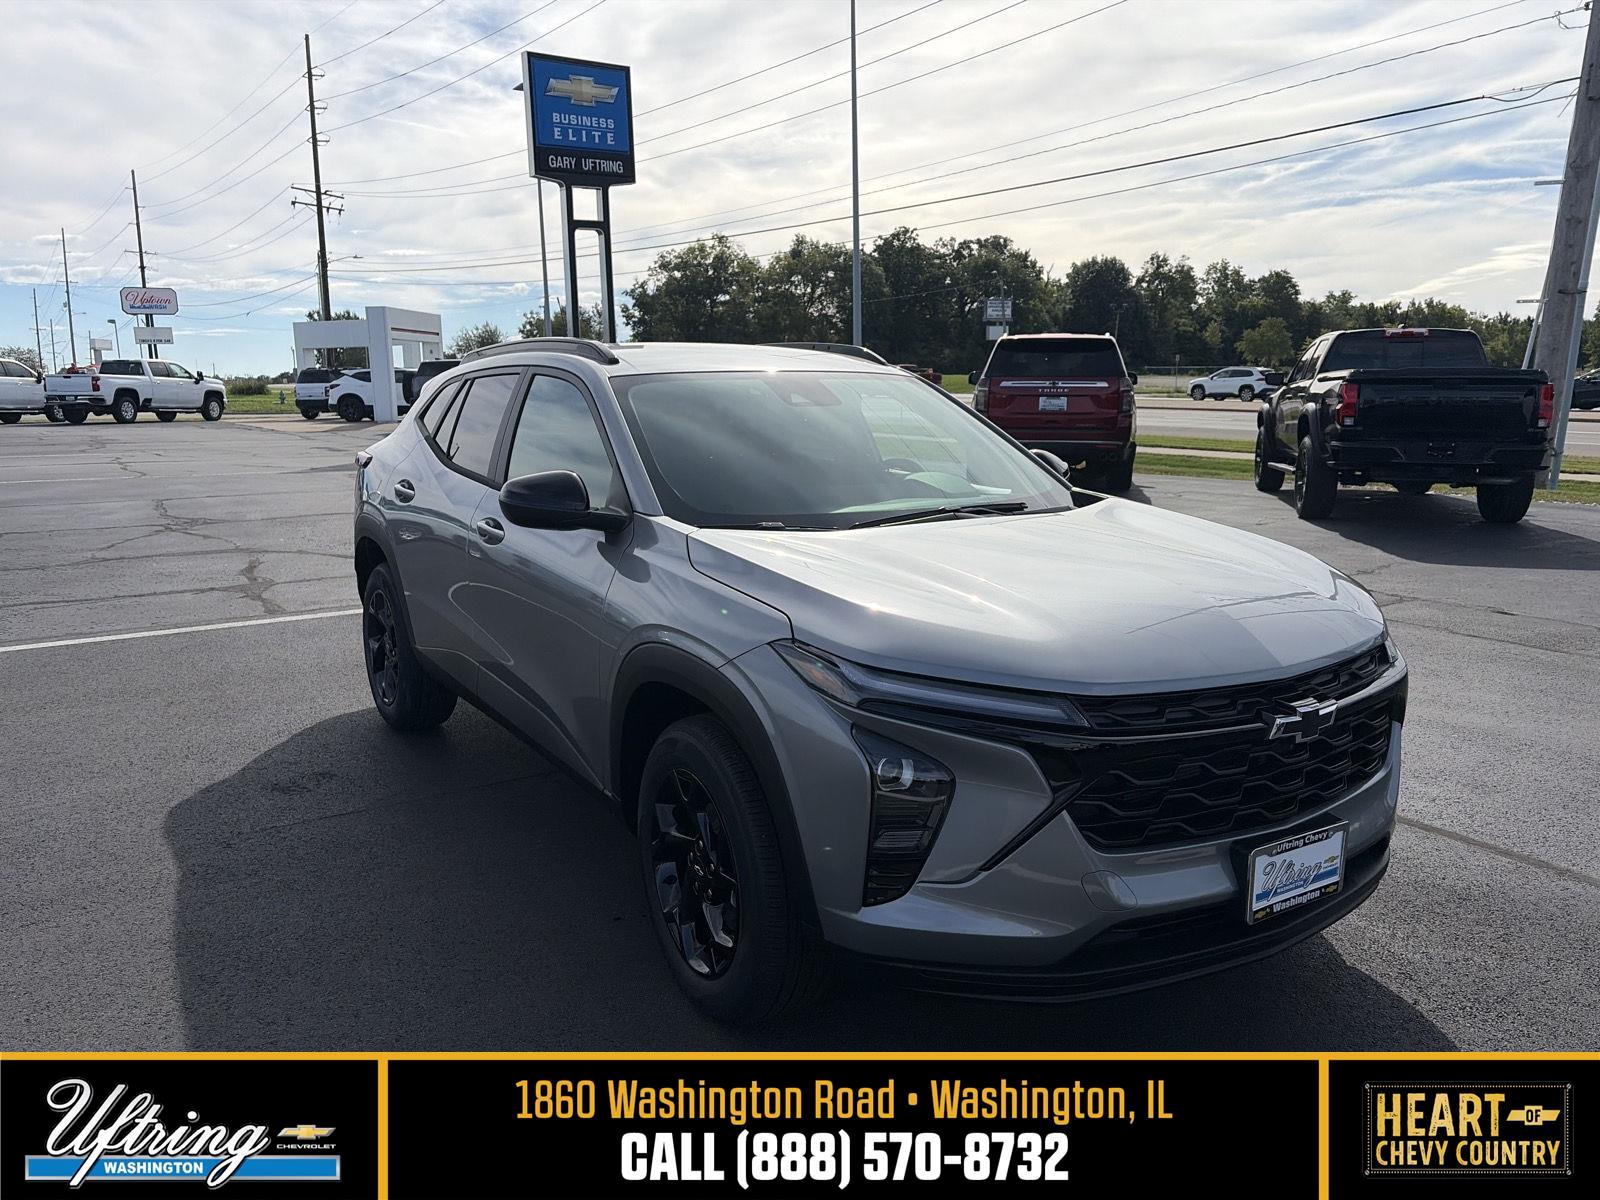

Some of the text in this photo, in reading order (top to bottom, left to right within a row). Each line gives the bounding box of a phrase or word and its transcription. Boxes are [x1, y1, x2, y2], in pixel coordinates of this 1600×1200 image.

[552, 112, 615, 128] BUSINESS
[554, 127, 615, 144] ELITE
[549, 155, 624, 173] GARY UFTRING
[125, 291, 171, 306] Uptown
[1276, 830, 1328, 853] Uftring Chevy
[1262, 858, 1323, 902] Uftring
[1272, 889, 1321, 913] Washington
